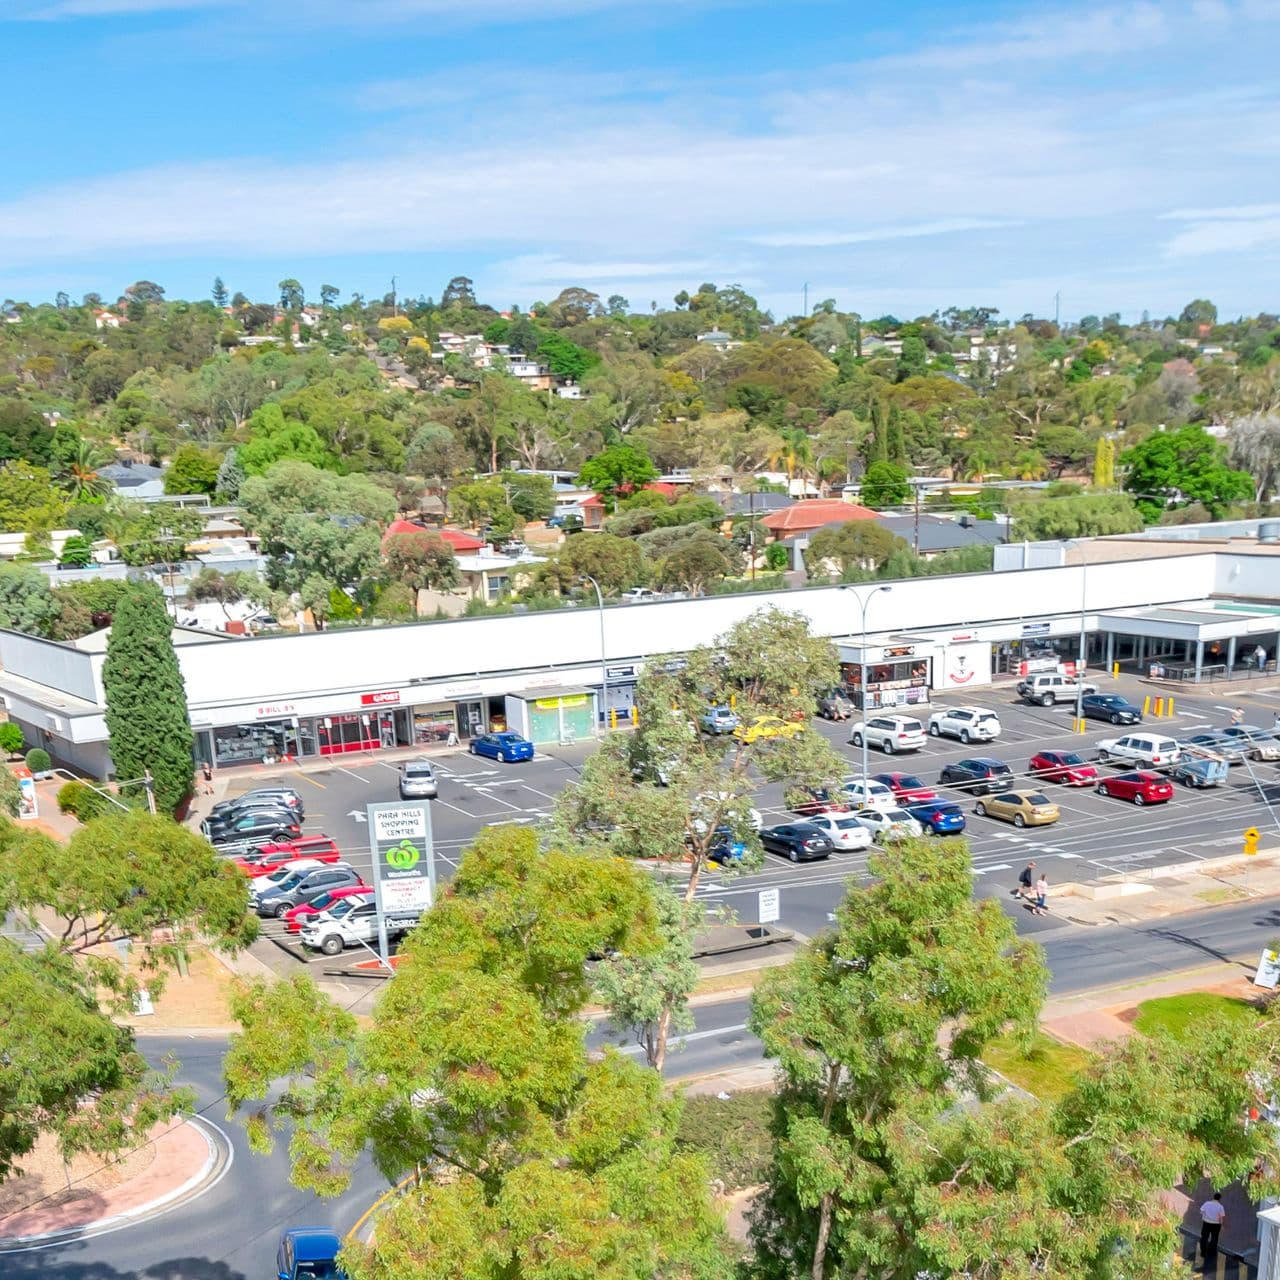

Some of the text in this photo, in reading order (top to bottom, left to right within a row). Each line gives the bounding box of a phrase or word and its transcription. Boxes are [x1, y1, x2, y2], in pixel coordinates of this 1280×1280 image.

[401, 810, 422, 818] HILLS
[381, 819, 419, 828] SHOPPING
[386, 828, 415, 837] CENTRE
